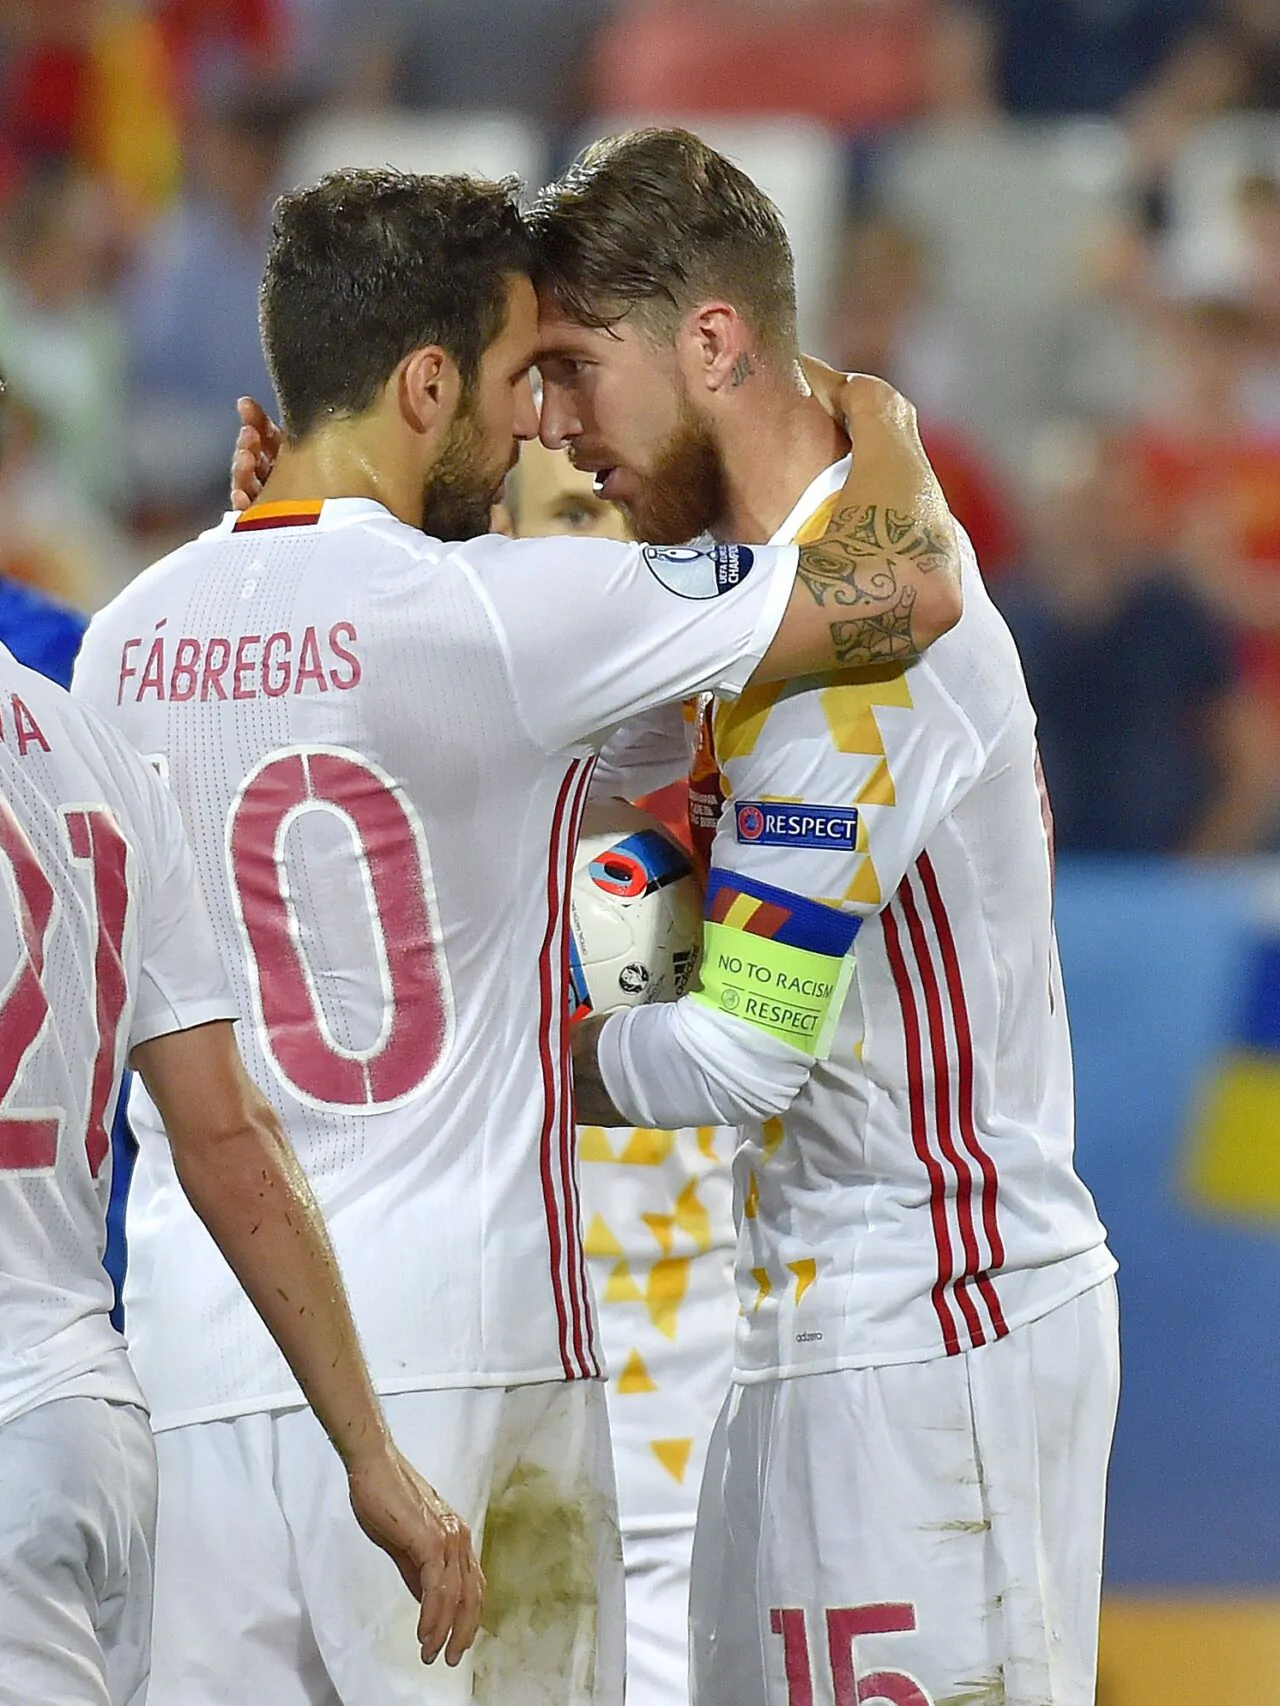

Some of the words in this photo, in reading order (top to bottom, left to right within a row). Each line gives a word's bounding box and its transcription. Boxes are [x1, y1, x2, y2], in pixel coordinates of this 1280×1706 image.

[719, 563, 728, 585] UEFA
[116, 617, 362, 706] FÁBREGAS
[765, 814, 857, 839] RESPECT
[227, 747, 453, 1113] 0
[718, 953, 743, 974] NO
[747, 962, 772, 983] TO
[776, 973, 834, 999] RACISM
[745, 998, 819, 1032] RESPECT
[769, 1602, 932, 1706] 15
